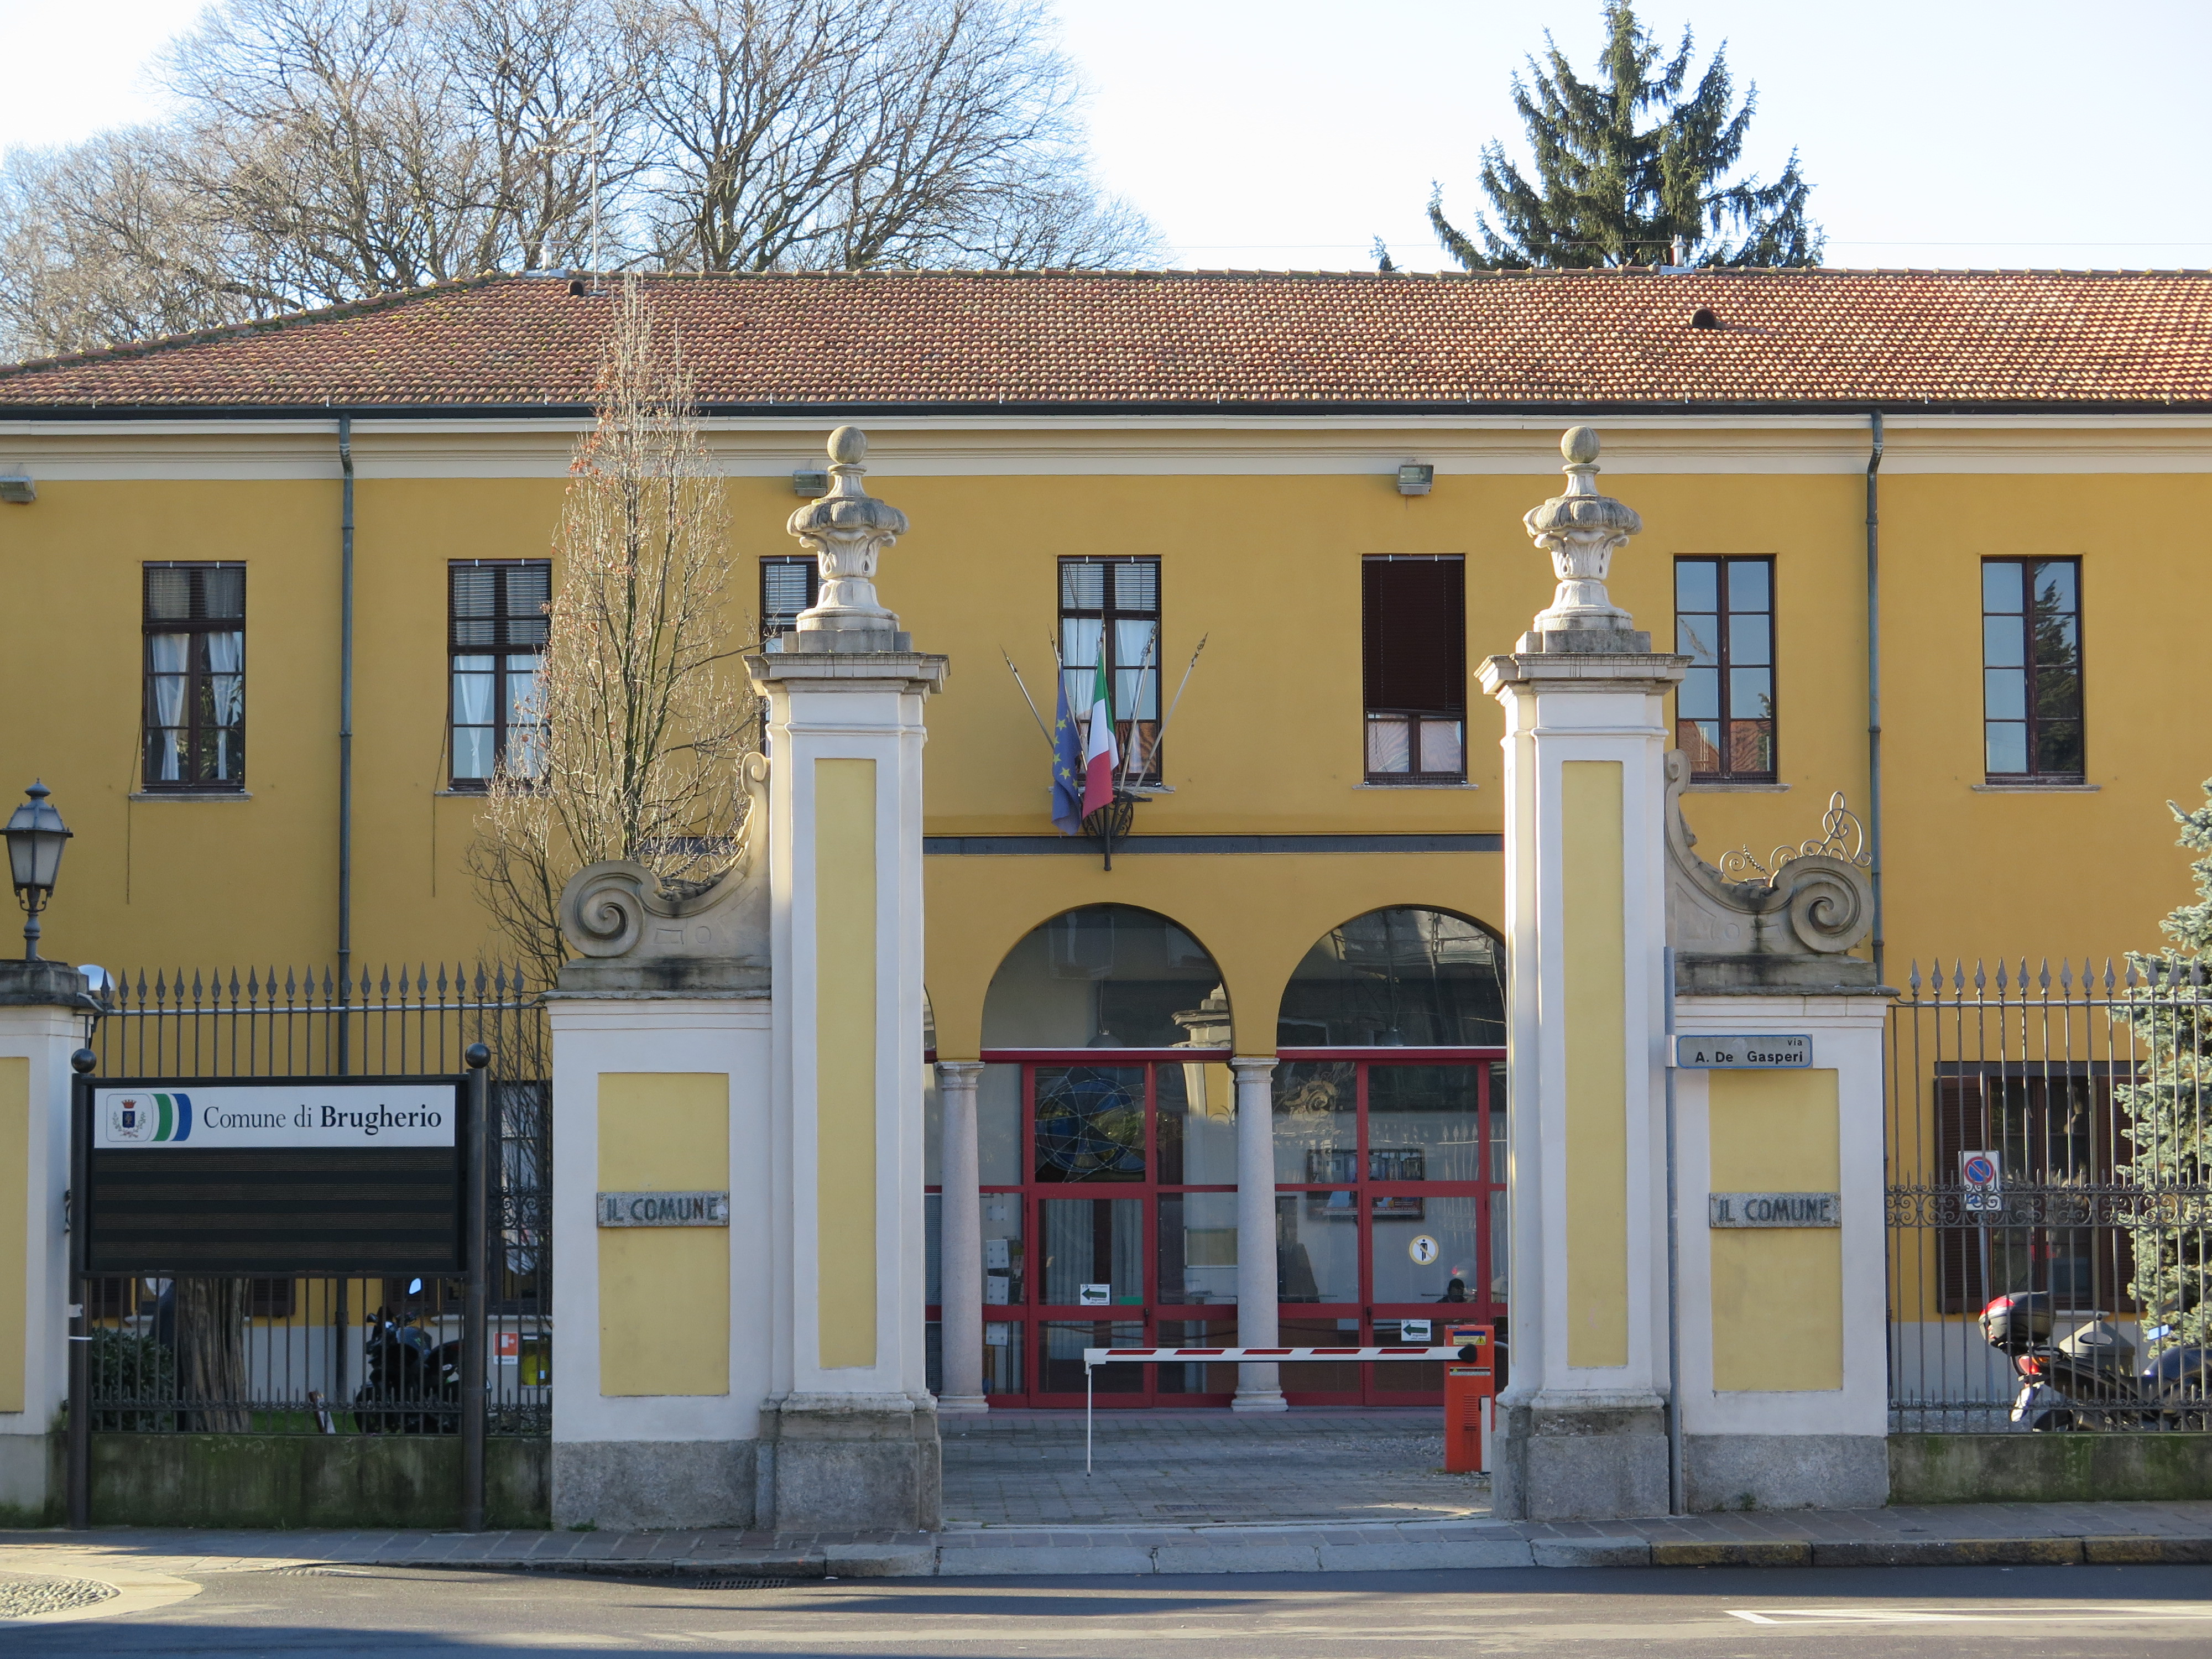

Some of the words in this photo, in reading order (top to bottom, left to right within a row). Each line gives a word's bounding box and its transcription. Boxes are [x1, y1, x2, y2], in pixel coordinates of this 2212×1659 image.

[1695, 1052, 1709, 1062] A.
[1715, 1052, 1733, 1062] De
[1747, 1051, 1803, 1064] Gasperi
[204, 1106, 286, 1128] Comune
[294, 1104, 312, 1128] di
[320, 1104, 441, 1136] Brugherio
[607, 1197, 623, 1221] IL
[630, 1197, 718, 1220] COMUNE
[1720, 1199, 1736, 1221] IL
[1745, 1198, 1830, 1221] COMUNE
